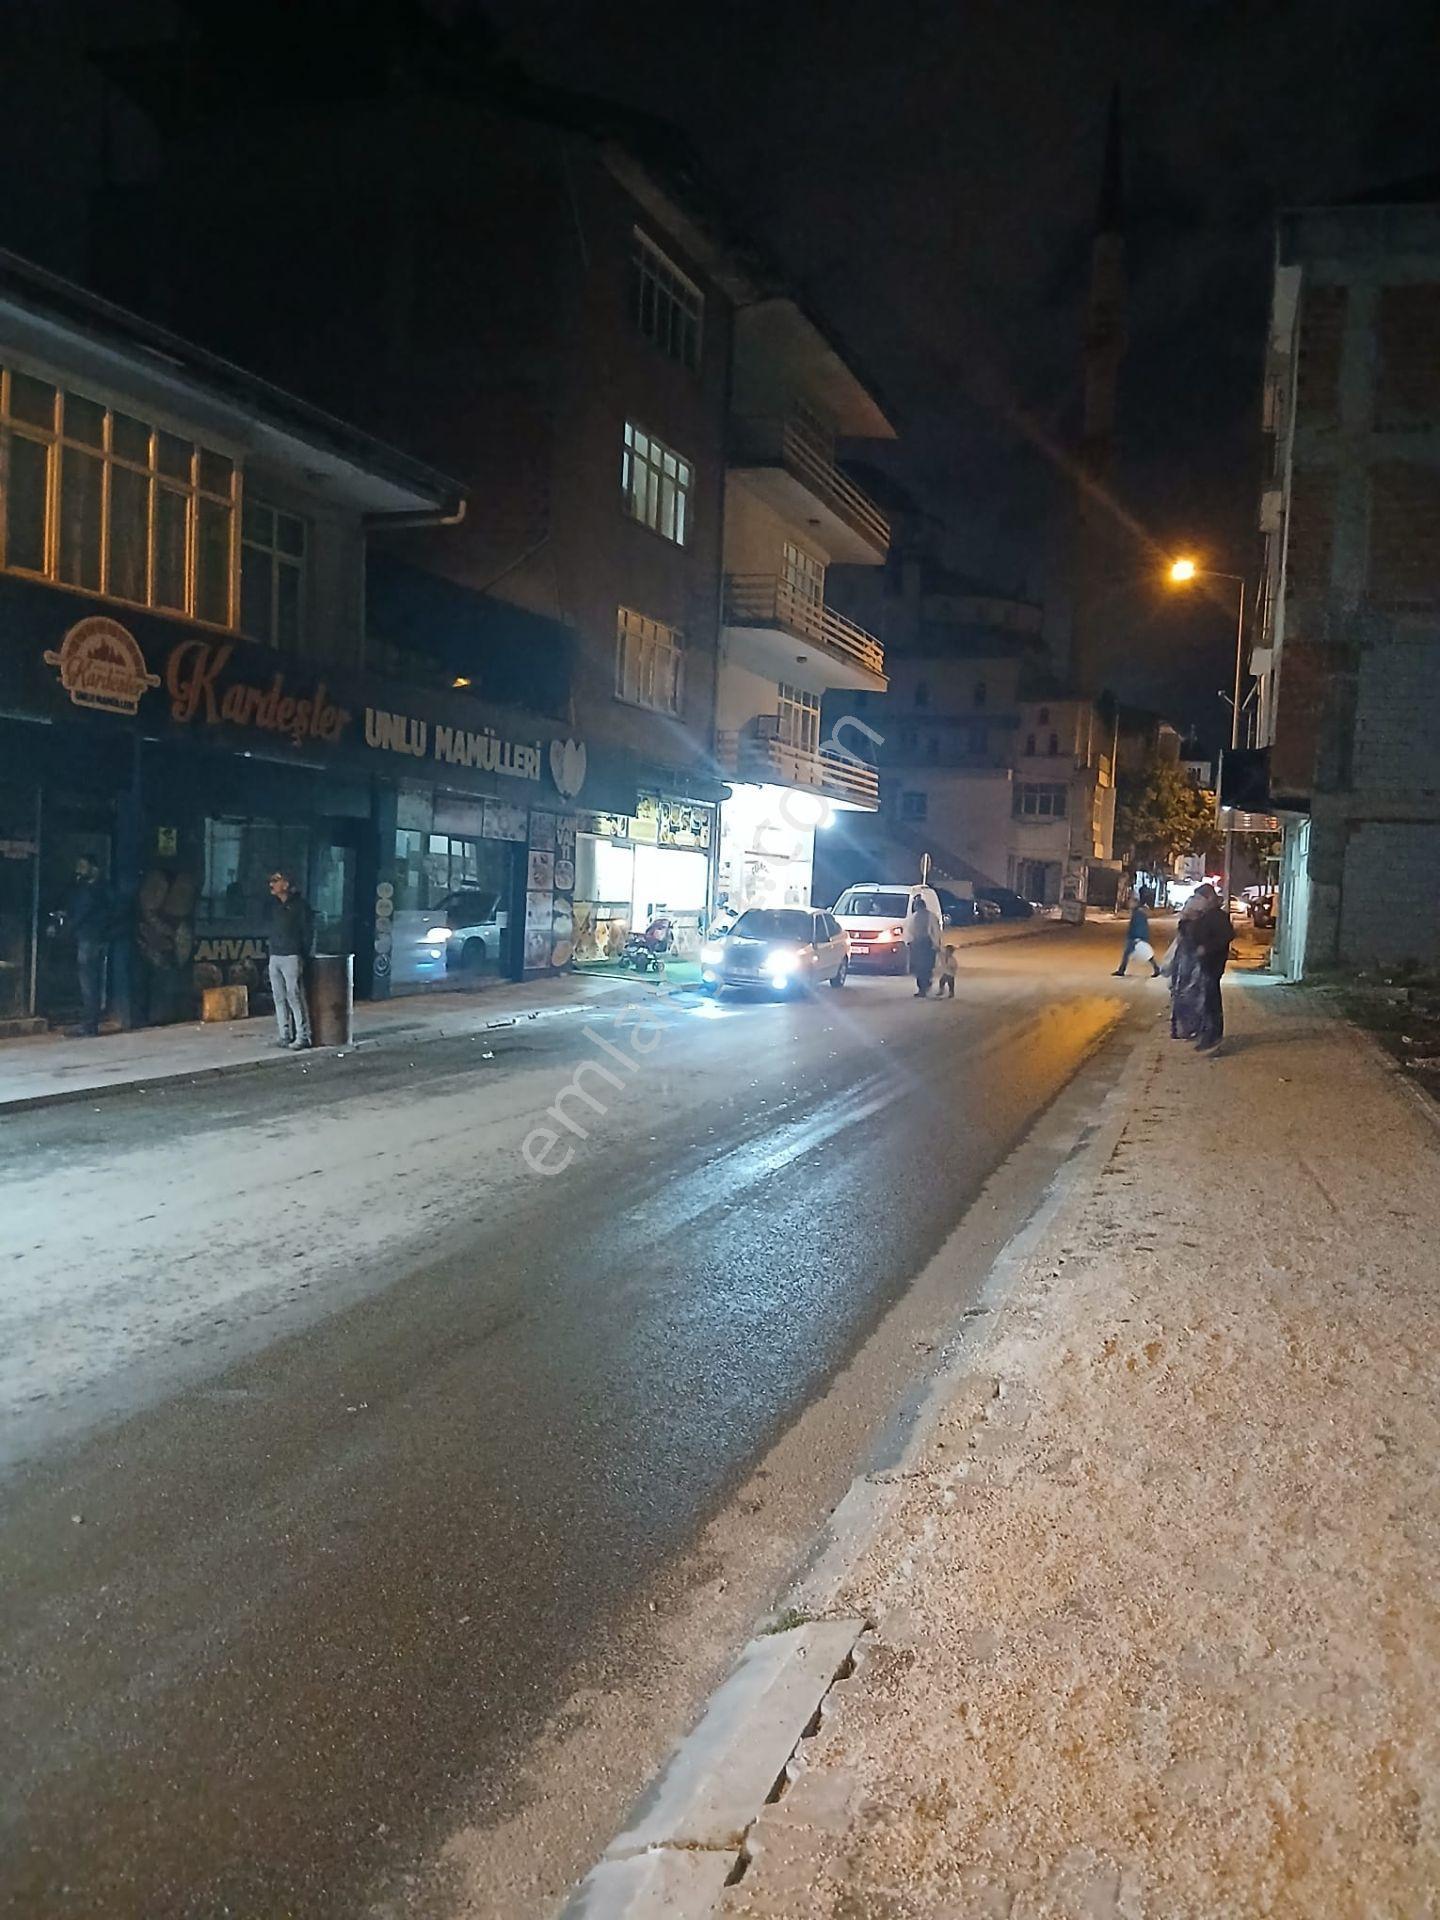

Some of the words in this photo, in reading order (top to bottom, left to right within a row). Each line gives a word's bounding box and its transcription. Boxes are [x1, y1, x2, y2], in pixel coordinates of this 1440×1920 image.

[166, 640, 352, 748] Kardeşler
[434, 726, 541, 782] MAMÜLLERİ
[193, 938, 269, 960] AHVAL
